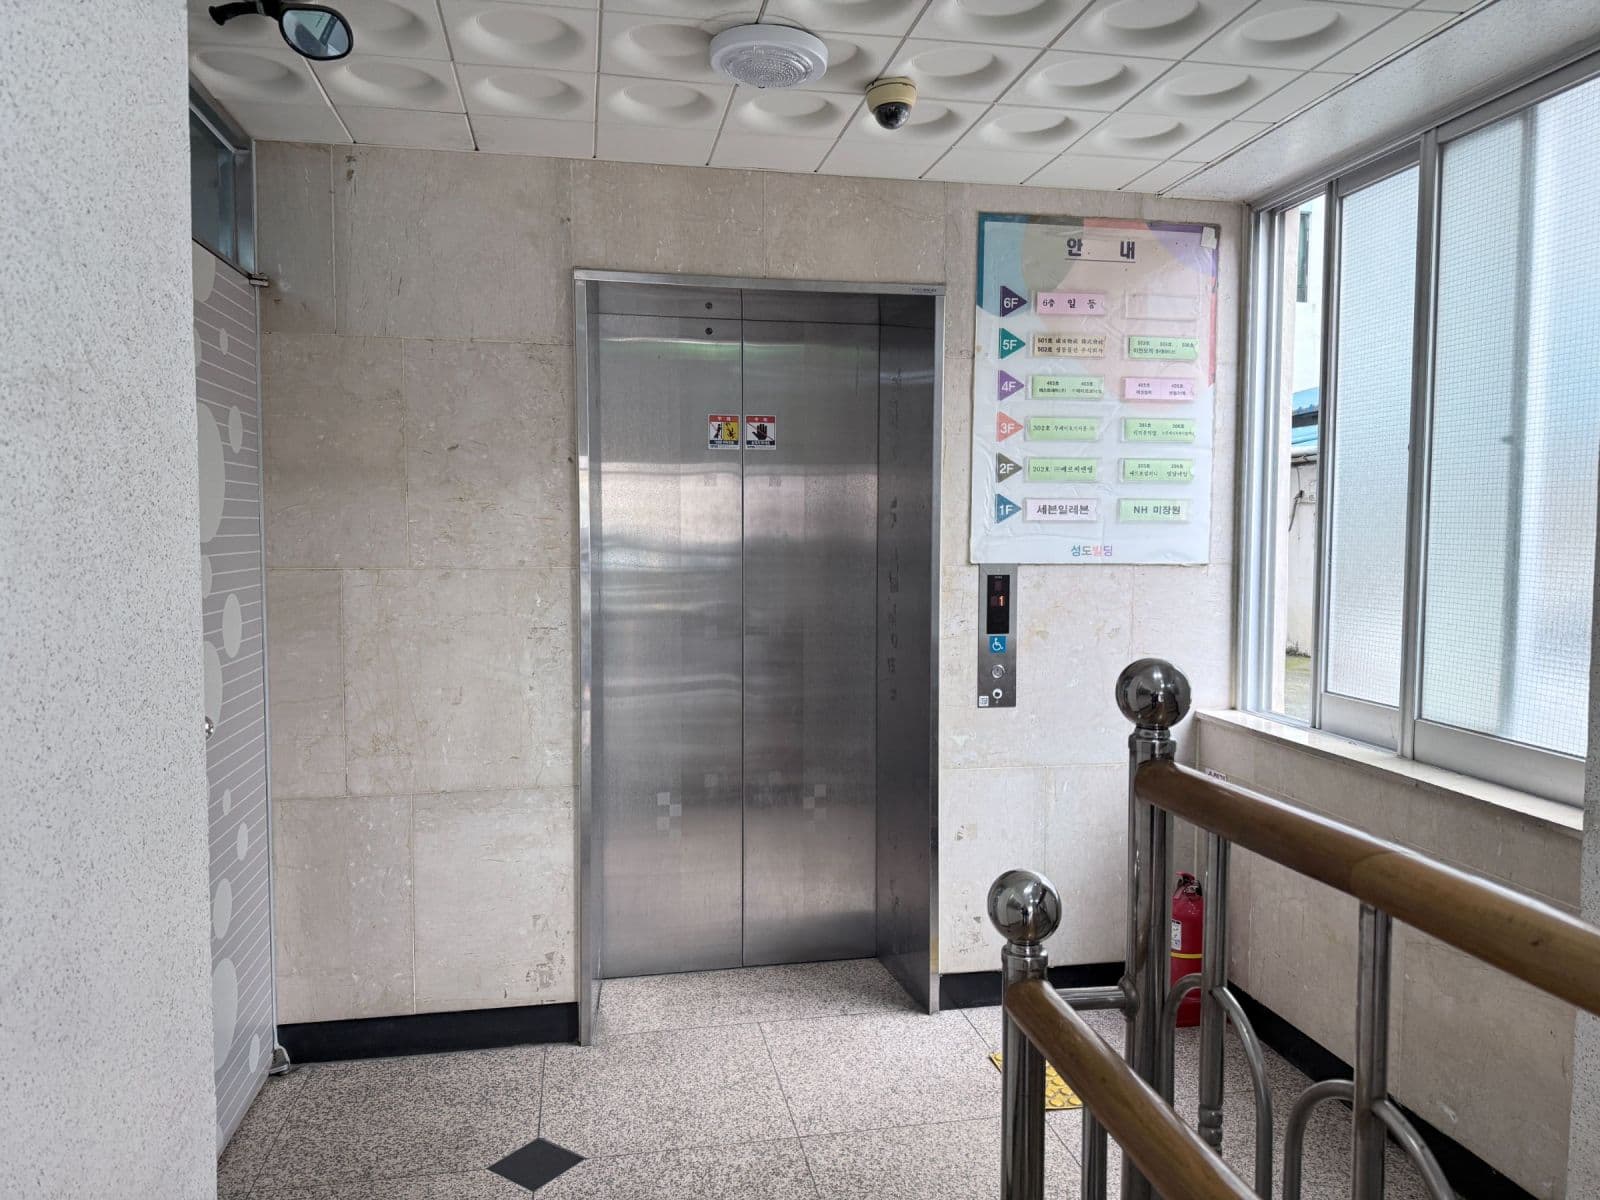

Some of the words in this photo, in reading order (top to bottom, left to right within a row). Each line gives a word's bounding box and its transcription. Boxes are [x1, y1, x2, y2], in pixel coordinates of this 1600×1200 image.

[1066, 237, 1083, 257] 안
[1120, 240, 1136, 259] 내
[1003, 297, 1019, 308] 6F
[1002, 339, 1018, 350] 5F
[1001, 381, 1017, 392] 4F
[1000, 422, 1015, 434] 3F
[999, 463, 1014, 474] 2F
[999, 504, 1014, 516] 1F
[1036, 504, 1090, 515] 세븐일레븐
[1133, 505, 1148, 514] NH
[1152, 504, 1181, 515] 미장원
[1070, 544, 1113, 557] 성도빌딩
